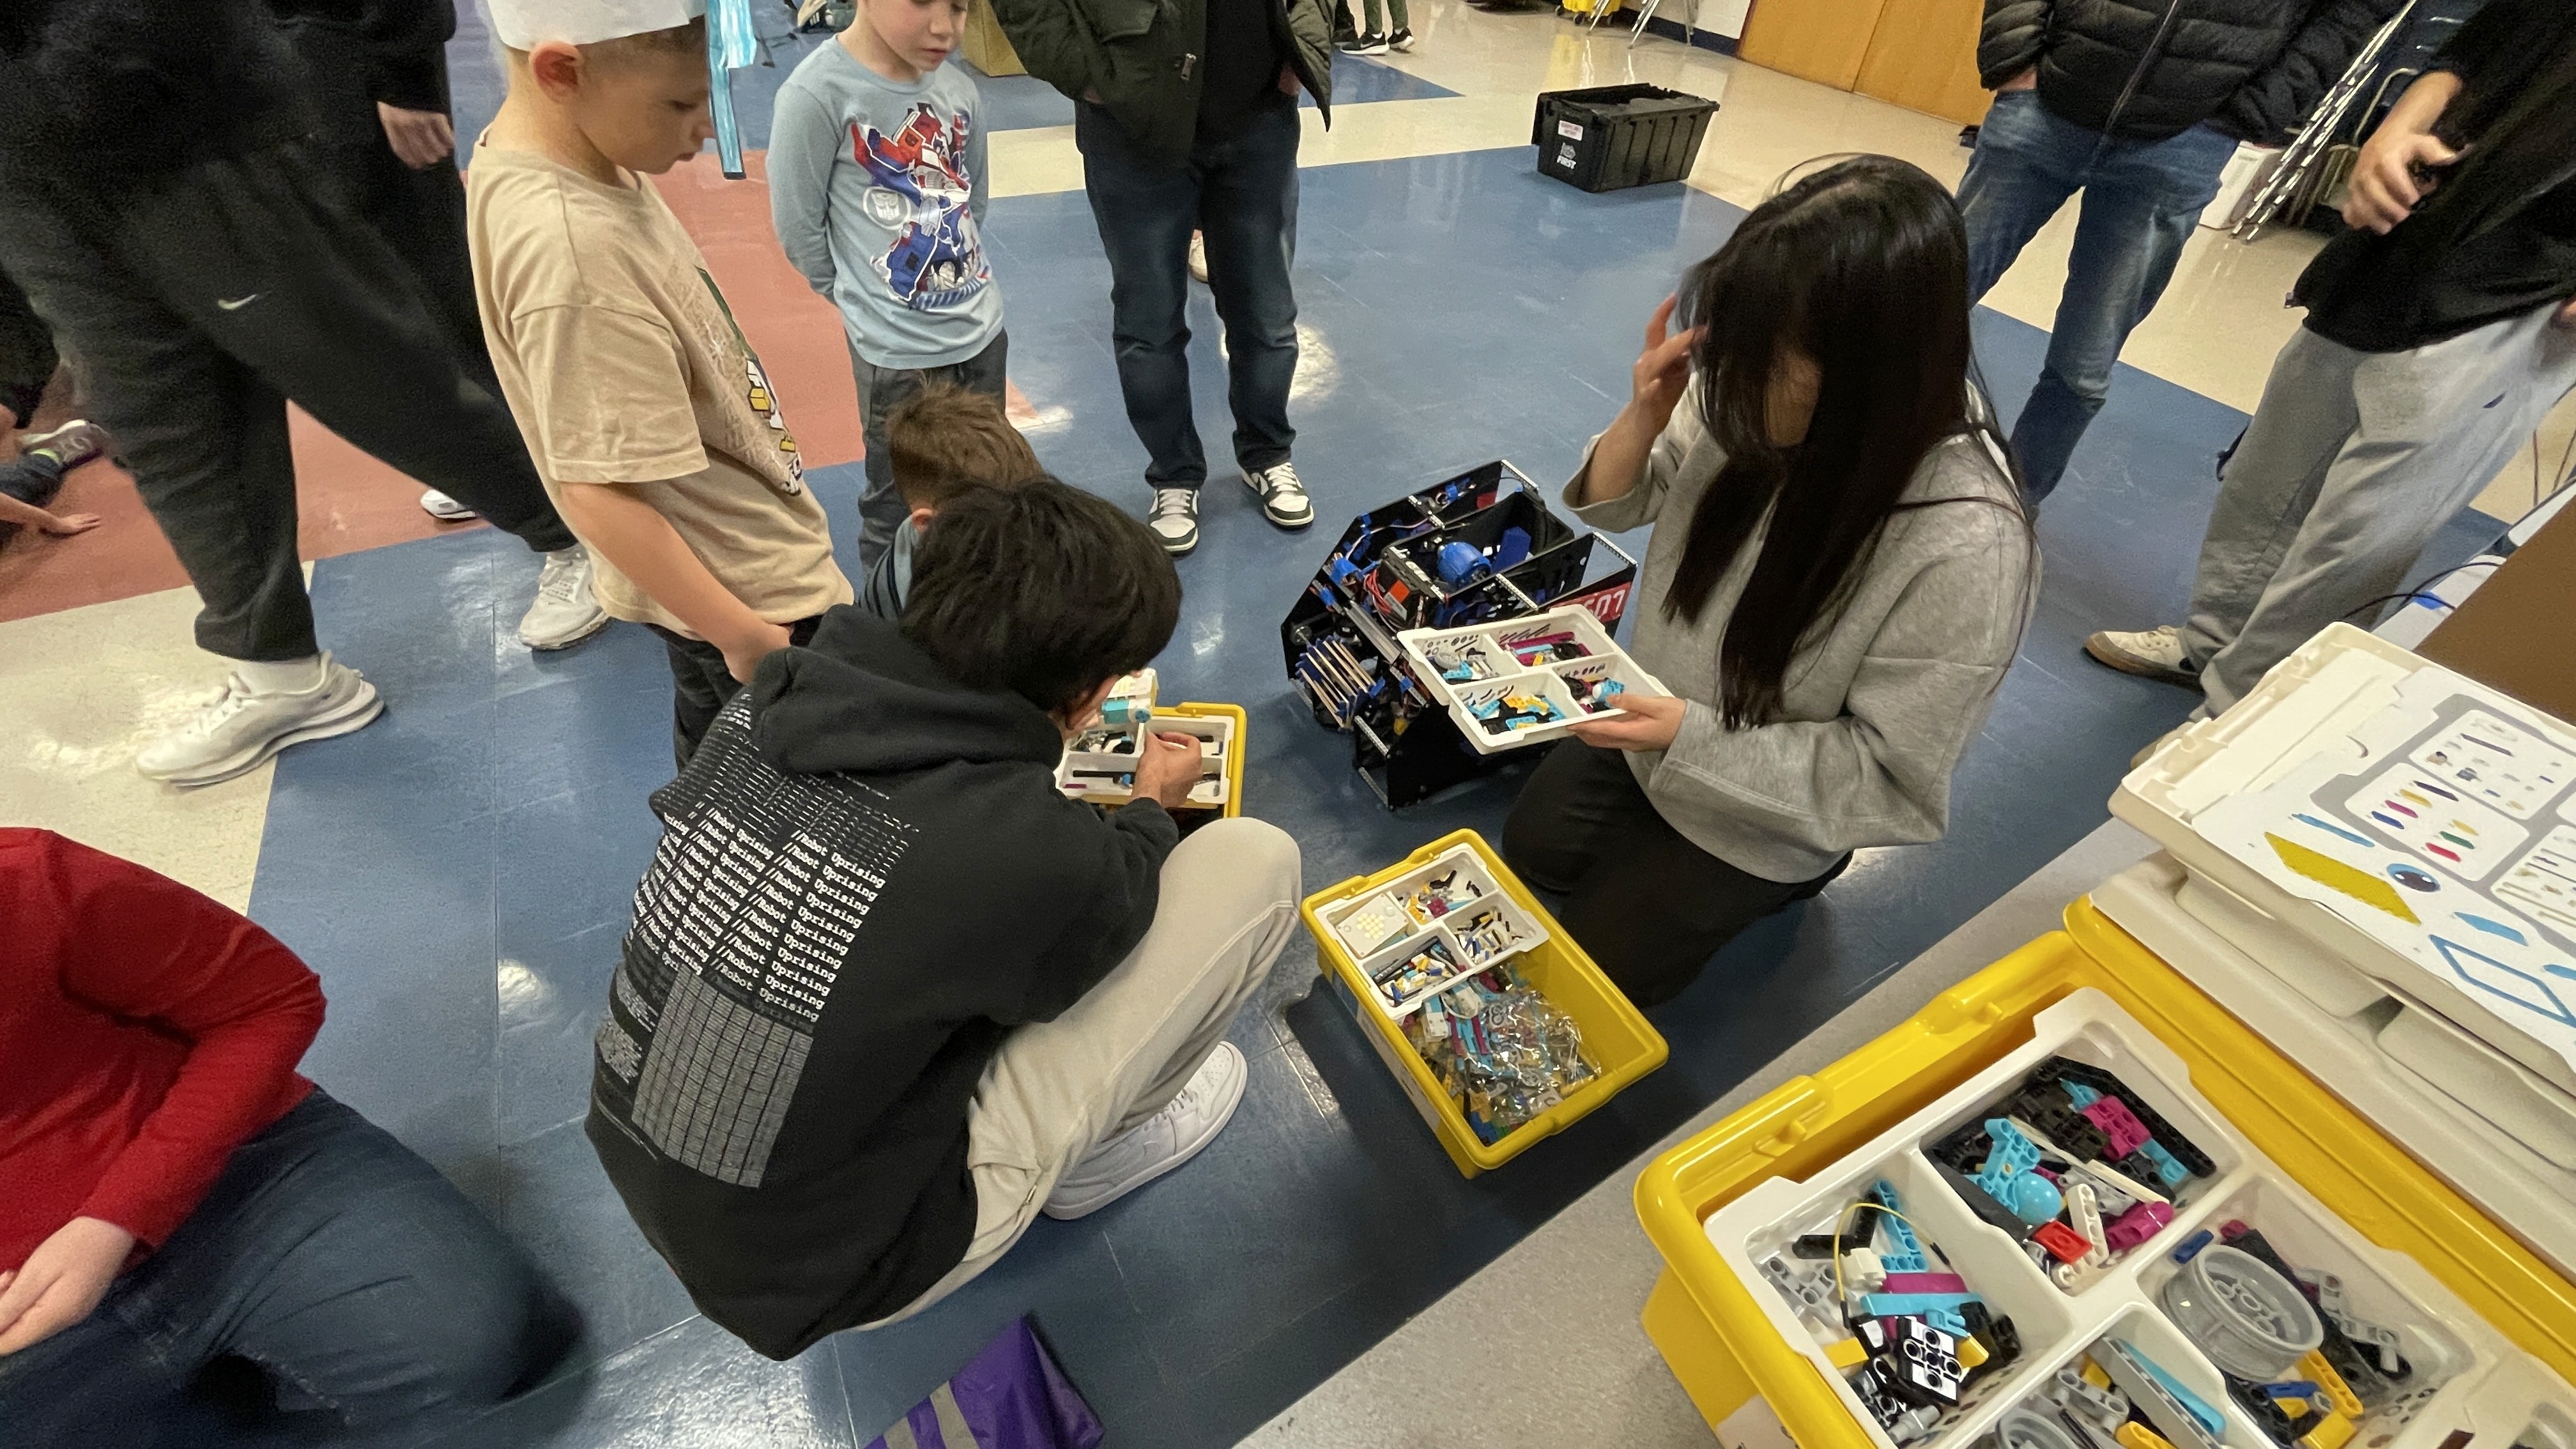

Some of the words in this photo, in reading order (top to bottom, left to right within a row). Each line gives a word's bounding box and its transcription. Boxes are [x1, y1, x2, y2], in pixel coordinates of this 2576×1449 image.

[720, 852, 757, 885] Uprising
[756, 880, 794, 910] //Robot
[798, 906, 855, 943] Uprising
[728, 840, 765, 873] Uprising
[765, 868, 803, 896] //Robot
[806, 892, 862, 928] Uprising
[737, 828, 774, 860] Uprising
[774, 854, 811, 883] //Robot
[814, 878, 870, 916] Uprising
[782, 842, 820, 870] //Robot
[822, 864, 878, 902] Uprising
[790, 830, 828, 856] //Robot
[831, 852, 886, 889] Uprising
[689, 901, 723, 937] Uprising
[724, 932, 766, 964] //Robot
[771, 960, 831, 997] Uprising
[696, 889, 732, 924] Uprising
[732, 919, 772, 951] //Robot
[778, 947, 837, 983] Uprising
[703, 877, 740, 911] Uprising
[739, 906, 779, 937] //Robot
[784, 933, 842, 969] Uprising
[712, 865, 749, 898] Uprising
[748, 893, 786, 923] //Robot
[791, 919, 848, 956] Uprising
[668, 939, 703, 976] Uprising
[675, 927, 709, 962] Uprising
[710, 958, 753, 991] //Robot
[759, 988, 820, 1022] Uprising
[682, 914, 716, 950] Uprising
[716, 946, 760, 978] //Robot
[765, 974, 825, 1010] Uprising
